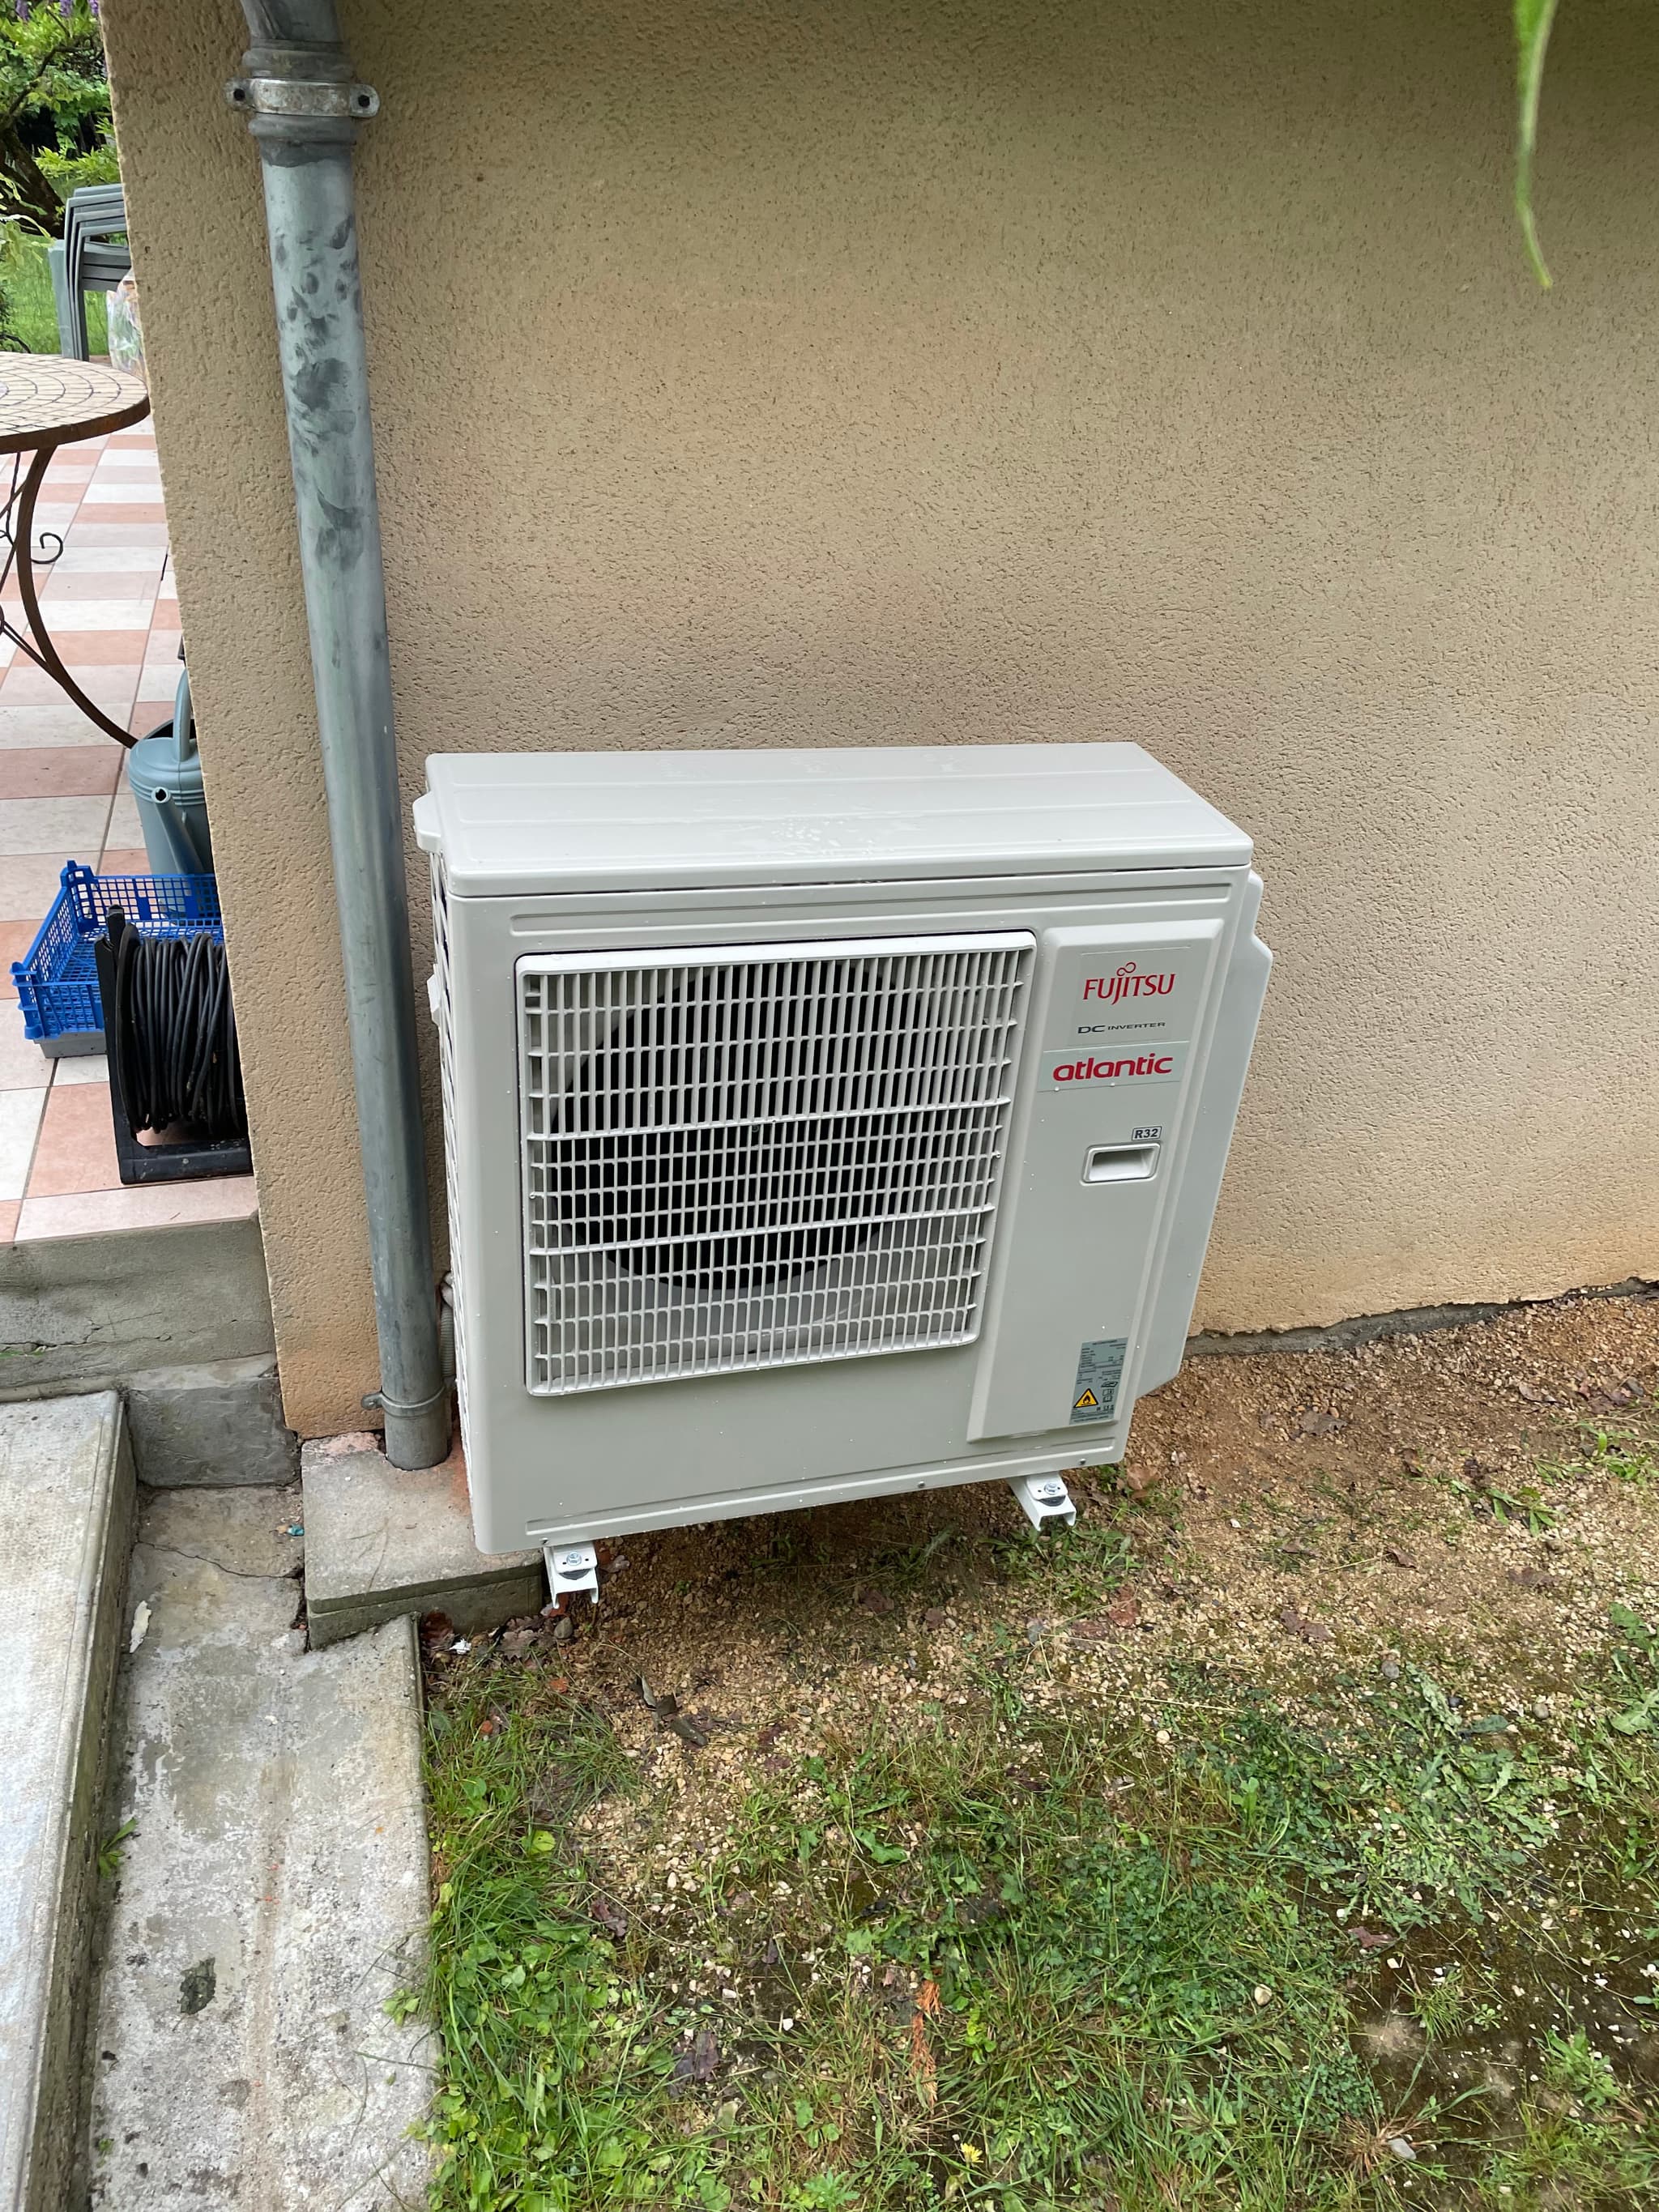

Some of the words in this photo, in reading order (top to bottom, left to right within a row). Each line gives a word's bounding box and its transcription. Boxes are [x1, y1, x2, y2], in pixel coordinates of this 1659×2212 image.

[1077, 1025, 1106, 1034] DC
[1107, 1021, 1166, 1031] INVERTER
[1052, 1053, 1173, 1082] atlantic
[1134, 1128, 1158, 1140] R32
